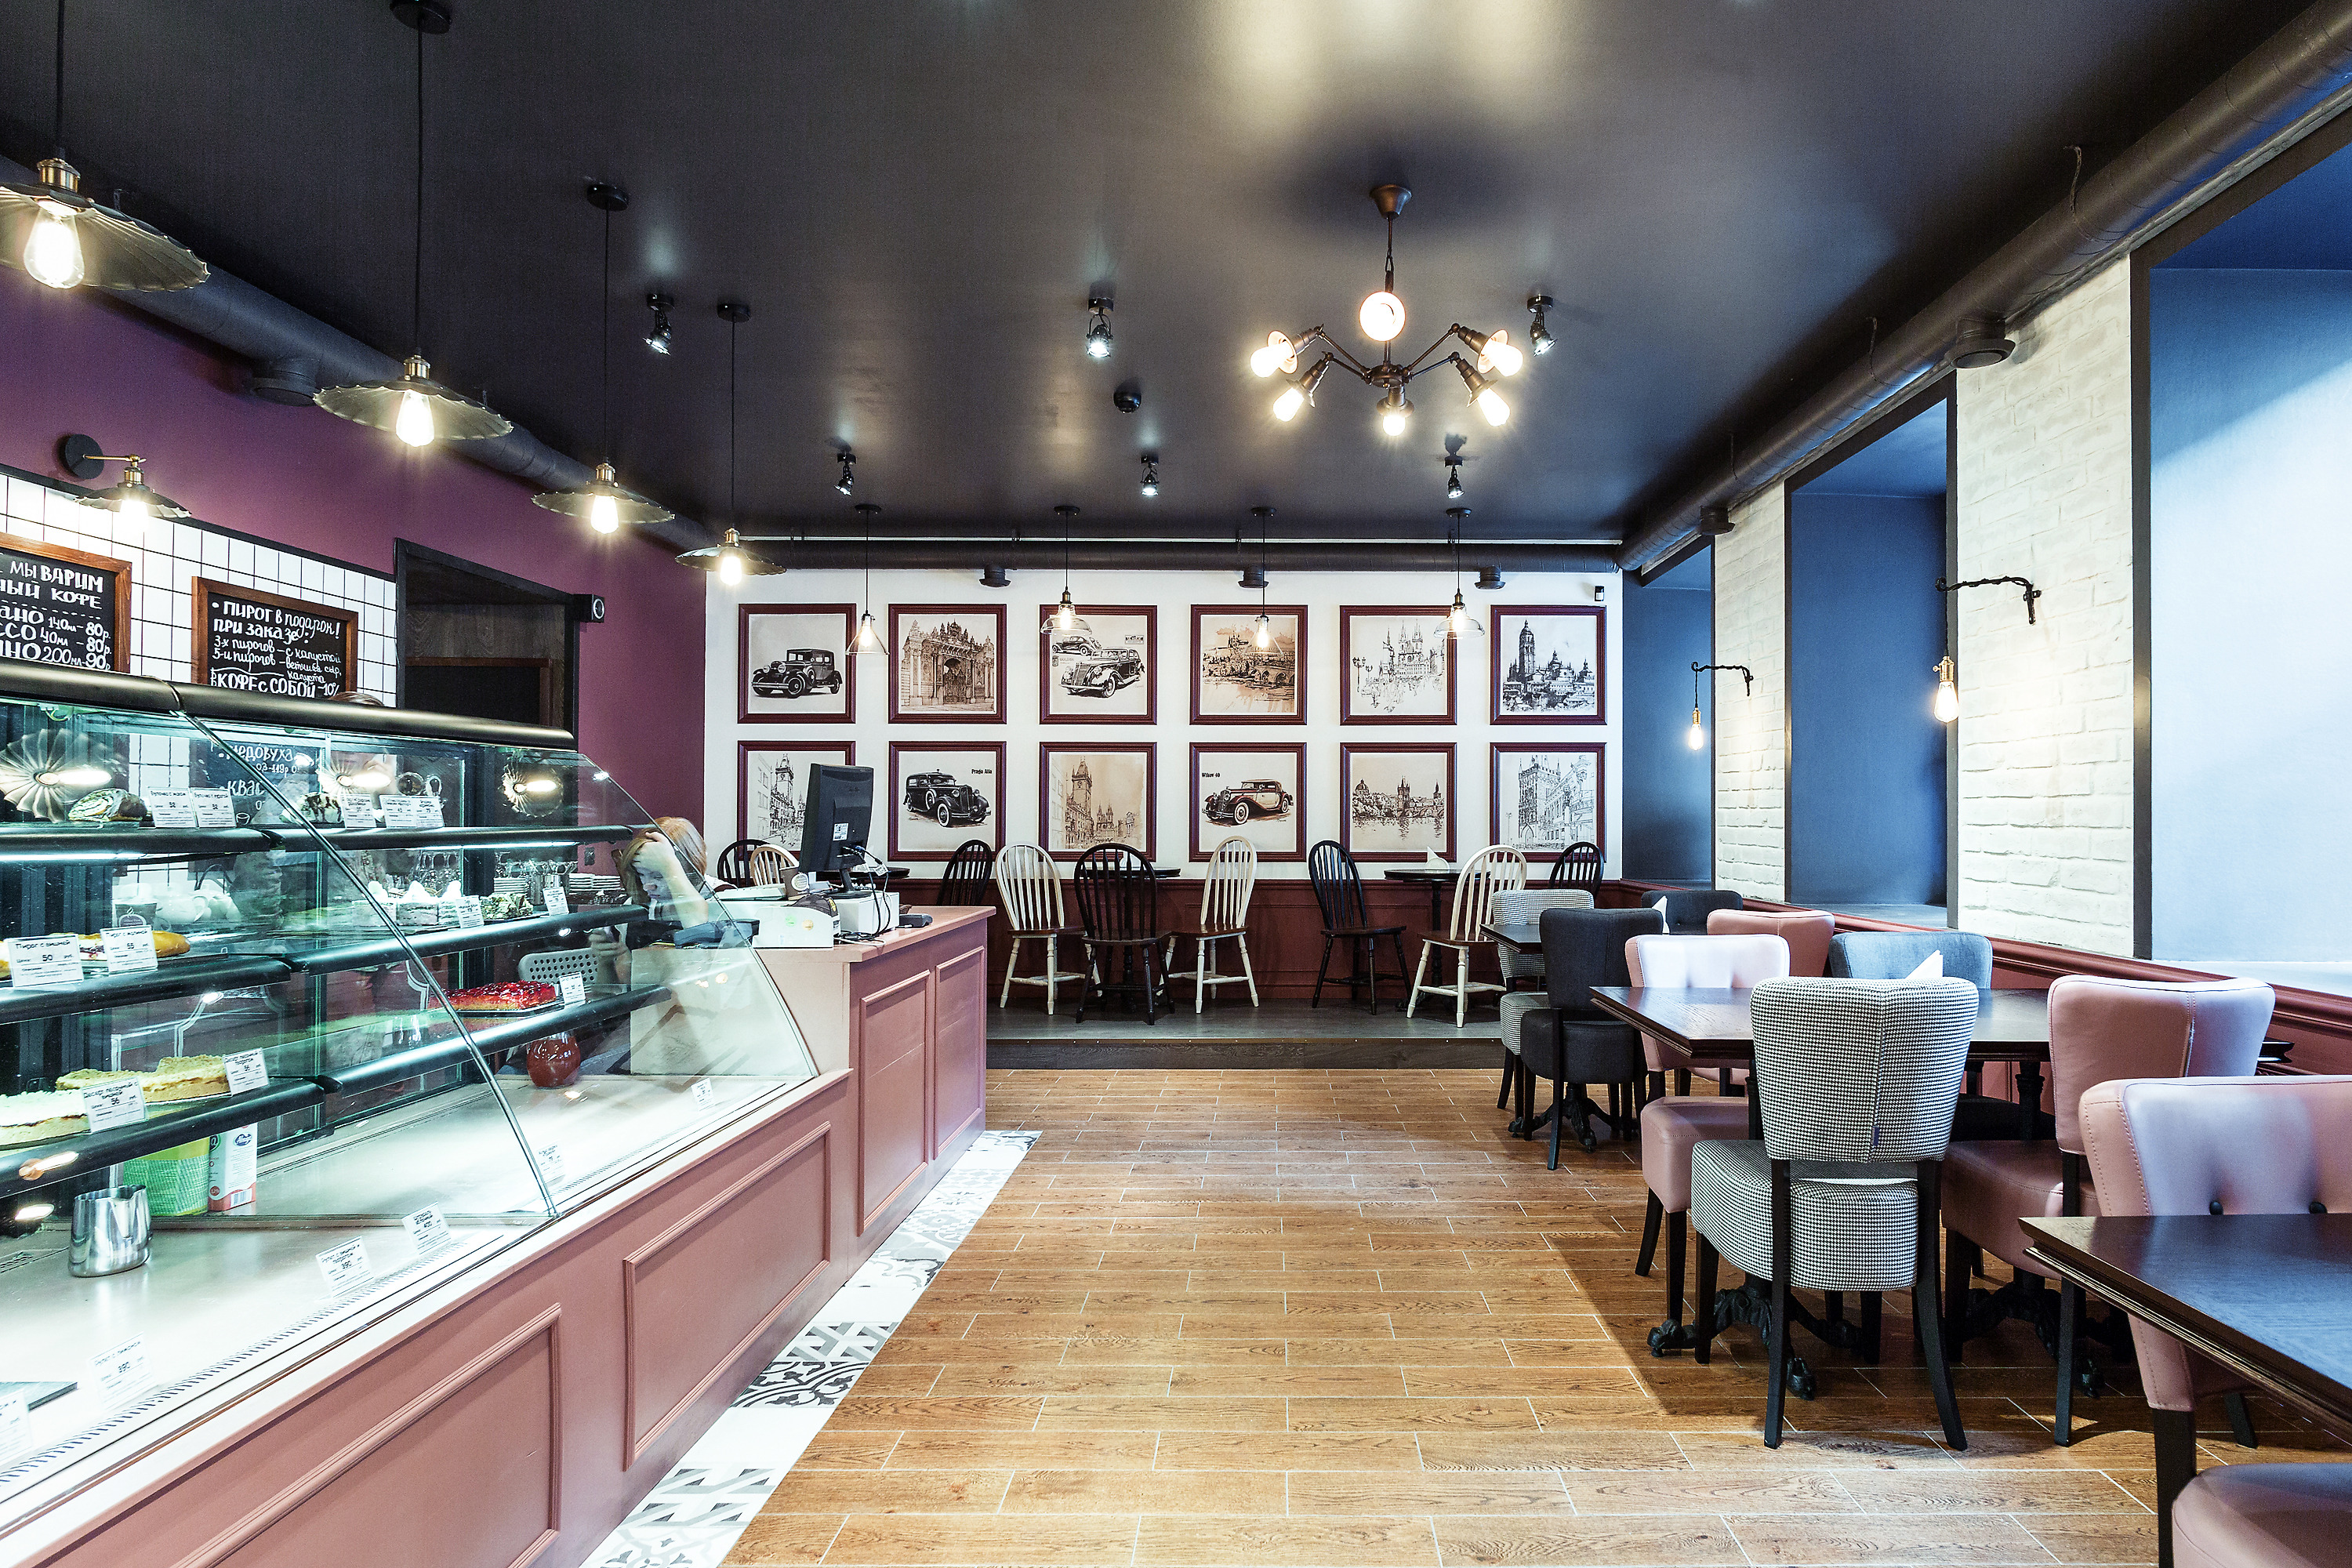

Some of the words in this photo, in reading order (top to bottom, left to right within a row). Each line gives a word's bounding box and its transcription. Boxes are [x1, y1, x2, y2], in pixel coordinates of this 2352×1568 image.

[40, 564, 103, 593] ВАРИМ
[51, 587, 103, 610] КОФЕ
[223, 601, 274, 622] ПИРОГ
[231, 639, 275, 655] пирогов
[233, 651, 276, 673] пирогов
[217, 673, 258, 691] КОФЕ
[269, 677, 316, 699] СОБОЙ
[42, 953, 53, 962] 50
[111, 1097, 120, 1105] 56
[118, 1360, 132, 1374] 390
